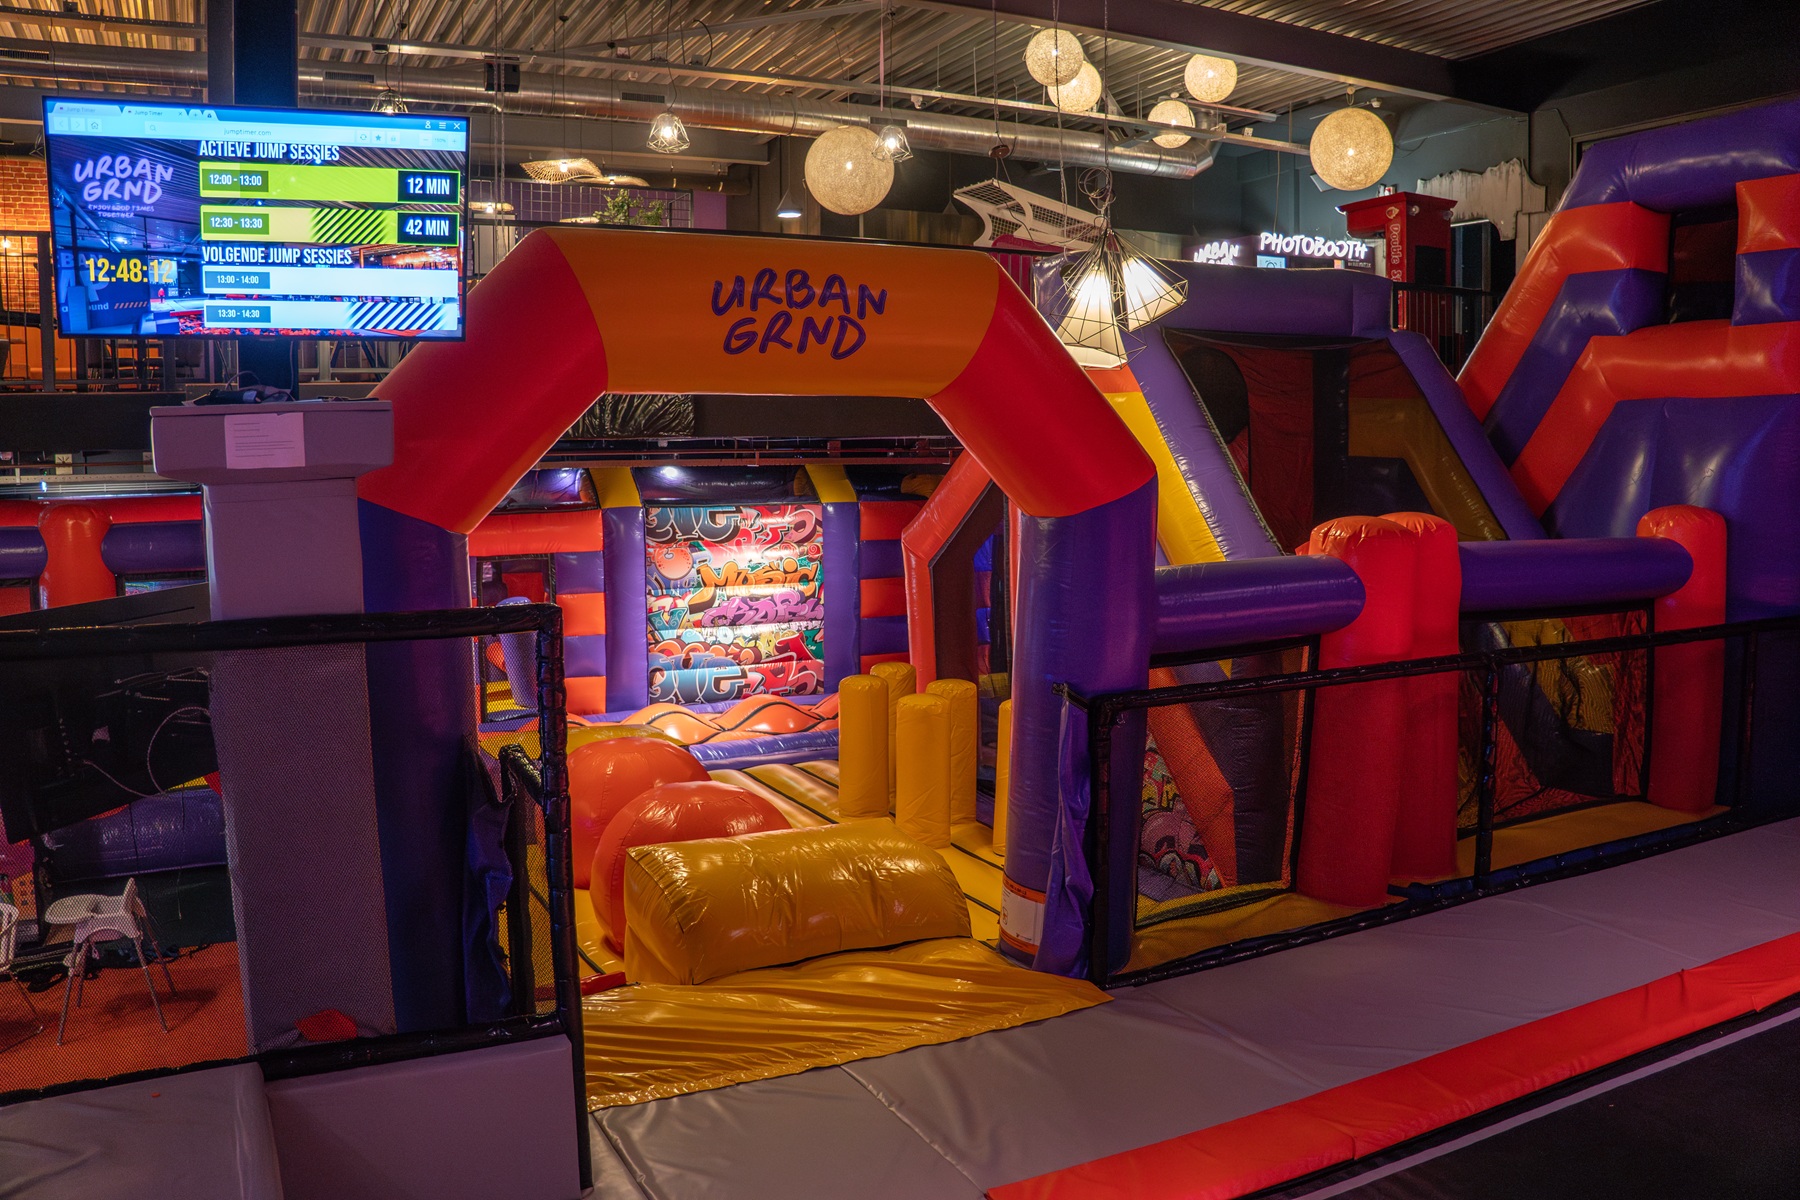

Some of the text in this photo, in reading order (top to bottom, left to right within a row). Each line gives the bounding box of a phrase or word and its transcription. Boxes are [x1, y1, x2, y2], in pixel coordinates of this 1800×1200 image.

[223, 128, 272, 137] jumptimer.com
[199, 140, 340, 161] ACTIEVE JUMP SESSIES
[74, 155, 174, 184] URBAN
[209, 174, 232, 185] 12:00
[239, 175, 262, 186] 13:00
[407, 177, 451, 195] 12 MIN
[83, 178, 163, 204] GRND
[210, 217, 233, 228] 12:30
[240, 218, 263, 229] 13:30
[405, 219, 449, 236] 42 MIN
[1260, 231, 1368, 260] PHOTOBOOTH
[1389, 223, 1403, 265] Double
[202, 246, 352, 265] VOLGENDE JUMP SESSIES
[85, 258, 173, 283] 12:48:12
[217, 275, 235, 284] 13:00
[241, 275, 259, 284] 14:00
[711, 267, 887, 320] URBAN
[218, 309, 236, 318] 13:30
[242, 309, 260, 318] 14:30
[723, 310, 866, 360] GRND
